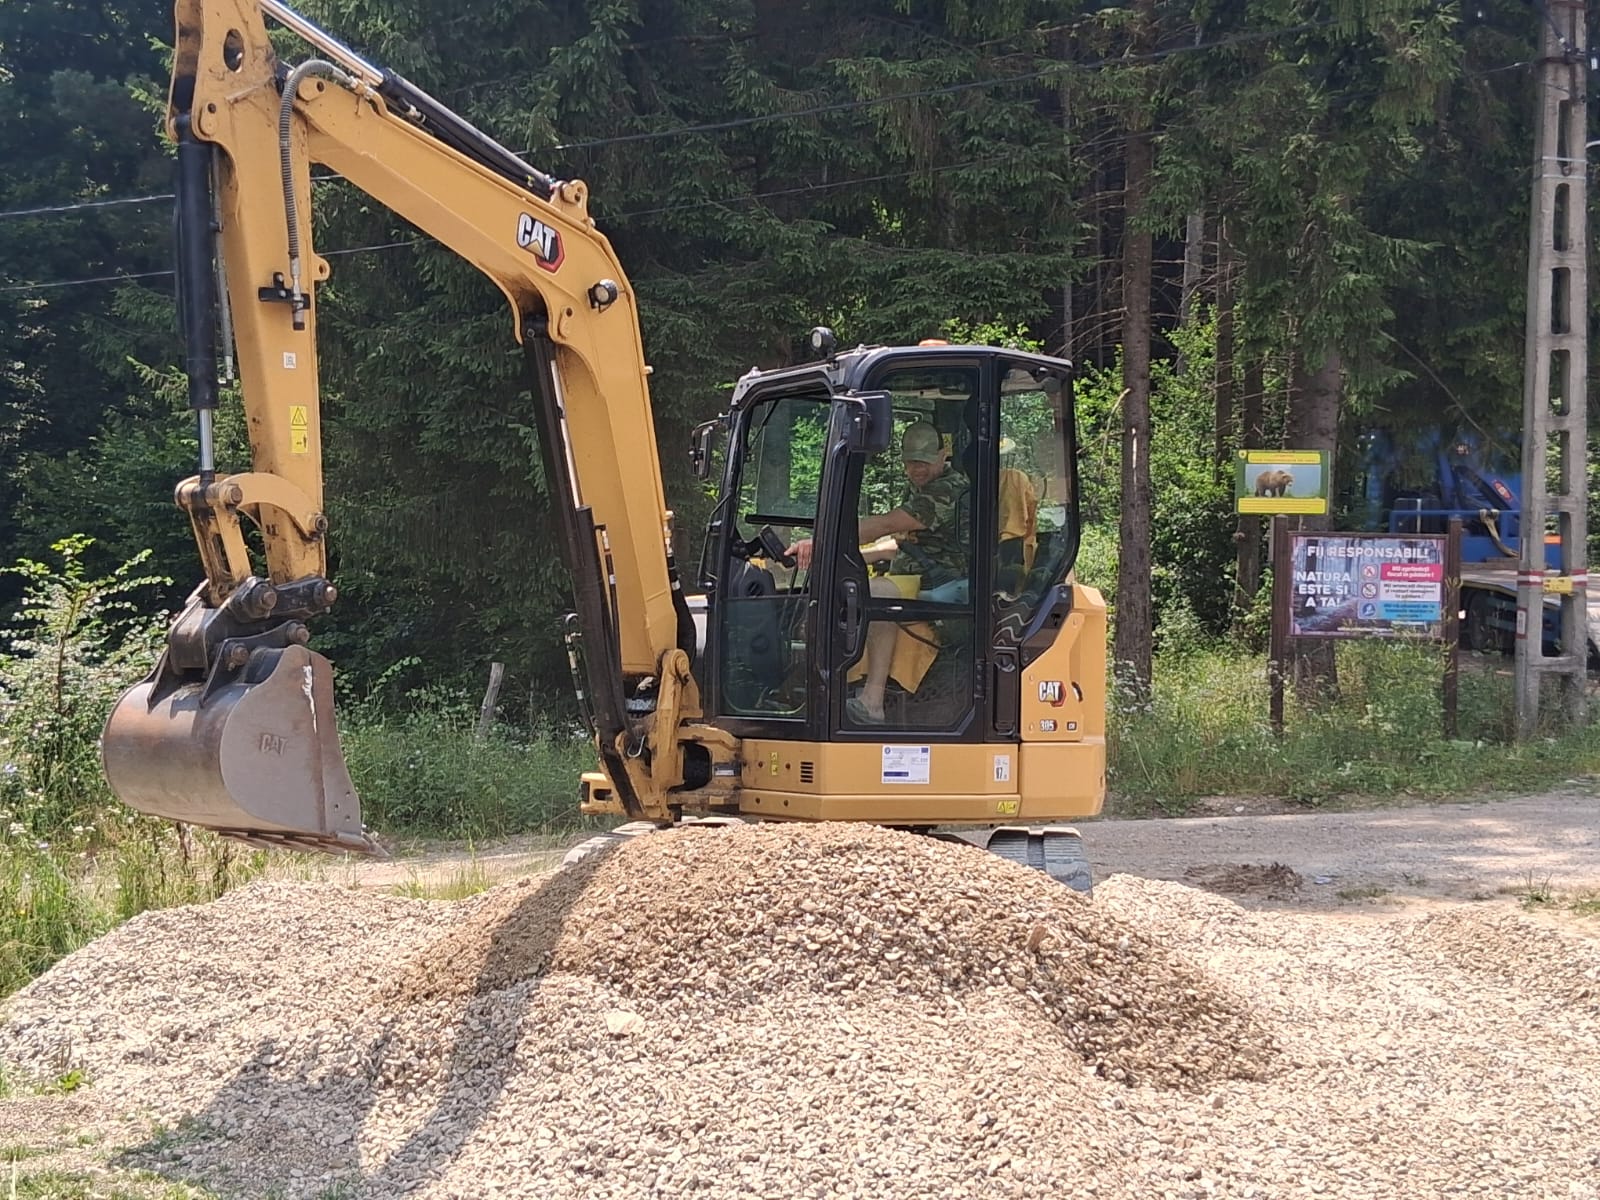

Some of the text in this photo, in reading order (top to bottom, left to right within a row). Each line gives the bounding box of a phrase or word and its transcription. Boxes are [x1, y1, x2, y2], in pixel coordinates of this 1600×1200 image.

[517, 212, 557, 261] CAT
[1327, 546, 1429, 559] RESPONSABIL!
[1296, 571, 1351, 582] NATURA
[1299, 584, 1331, 595] ESTE
[1305, 597, 1341, 608] A TA!
[1039, 681, 1061, 701] CAT
[1040, 719, 1055, 731] 305
[260, 733, 289, 757] CAT
